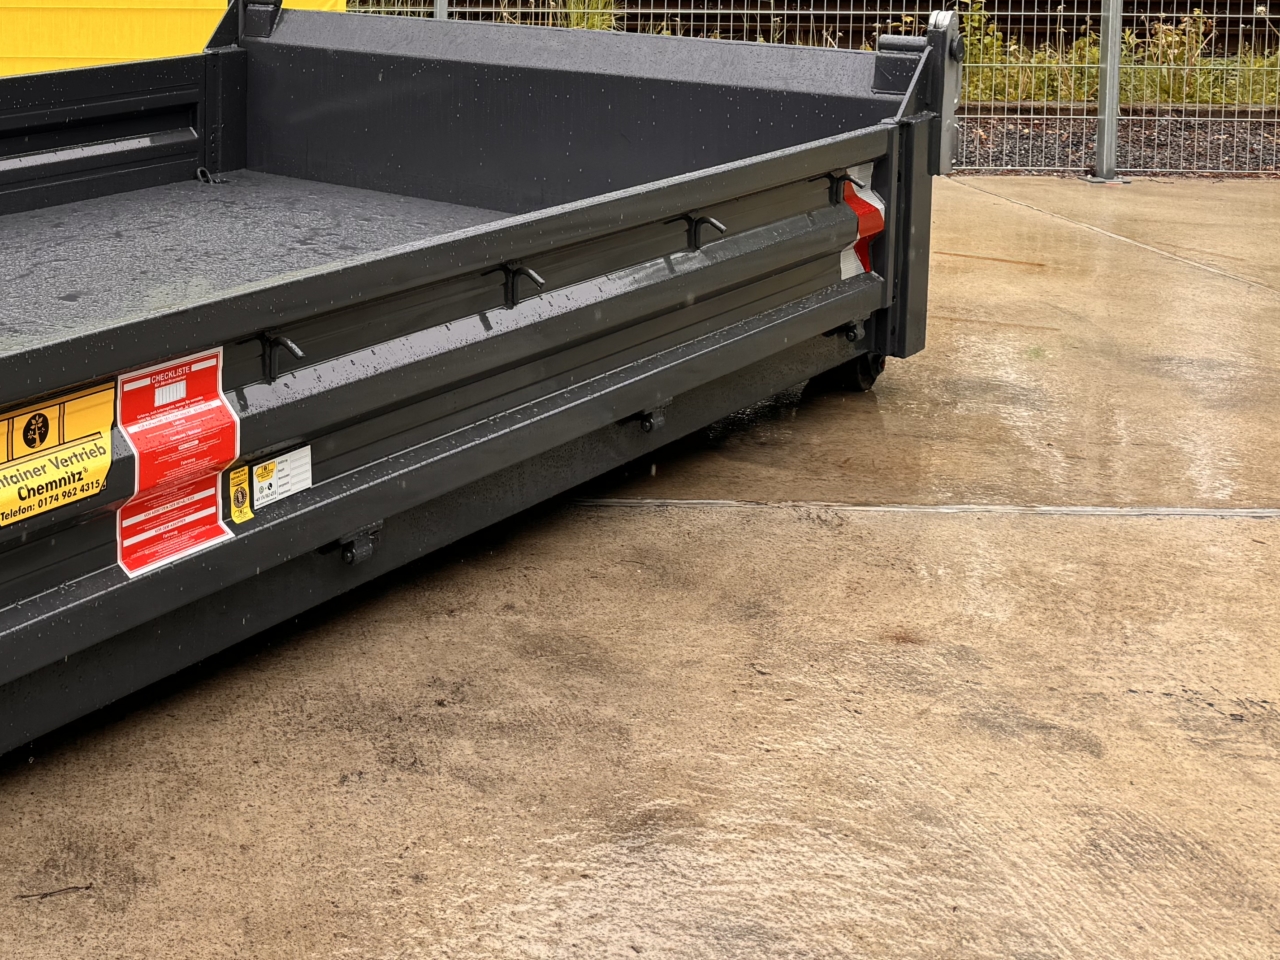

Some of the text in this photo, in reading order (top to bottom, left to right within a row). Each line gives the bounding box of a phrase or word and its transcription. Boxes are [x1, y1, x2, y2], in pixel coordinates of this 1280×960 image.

[151, 366, 190, 383] CHECKLISTE
[48, 442, 107, 470] Vertrieb
[0, 479, 100, 521] Telefon: 0174 962 4315
